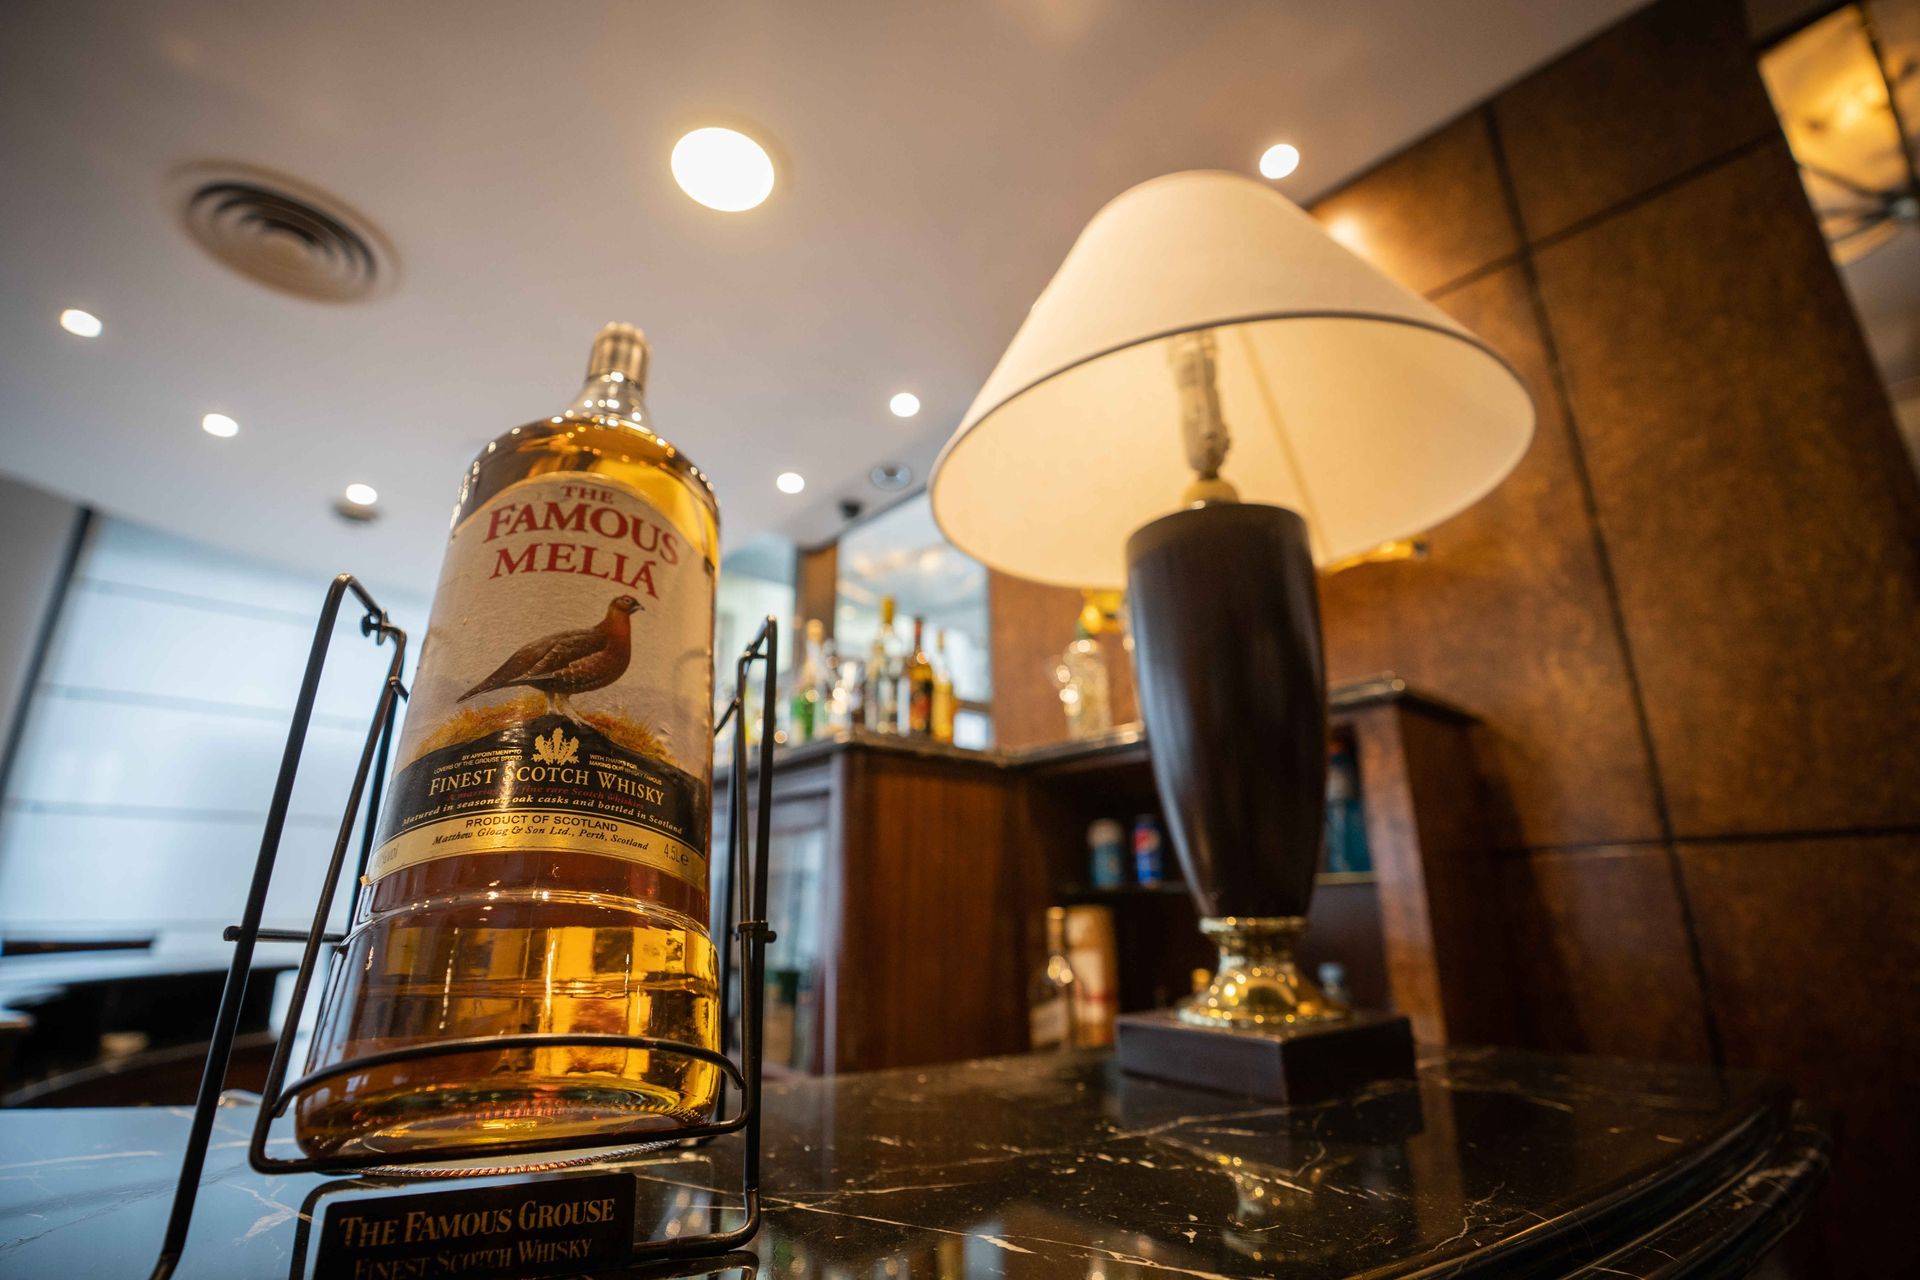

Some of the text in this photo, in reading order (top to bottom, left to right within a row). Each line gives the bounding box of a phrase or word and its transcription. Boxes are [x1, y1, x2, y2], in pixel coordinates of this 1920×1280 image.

[560, 485, 614, 504] THE
[483, 502, 679, 565] FAMOUS
[489, 543, 659, 600] MELIÁ
[475, 756, 500, 765] GROUSE
[589, 760, 611, 769] MAKING
[626, 762, 638, 770] FOR
[428, 768, 497, 797] FINEST
[502, 765, 590, 786] SCOTCH
[596, 770, 664, 806] WHISKY
[572, 787, 605, 800] Scotch
[401, 806, 440, 827] Matured
[442, 802, 454, 813] in
[512, 794, 534, 804] oak
[538, 794, 569, 805] casks
[572, 798, 595, 808] and
[598, 801, 635, 817] bottled
[636, 810, 647, 821] in
[648, 815, 683, 835] Scotland
[465, 815, 618, 833] PRODUCT OF SCOTLAND
[432, 831, 474, 846] Matthew
[525, 825, 546, 835] Son
[579, 828, 608, 842] Perth,
[610, 834, 649, 851] Scotland
[338, 1198, 616, 1248] THE FAMOUS GROUSE
[354, 1238, 593, 1280] FINEST SCOTCH WHISKY
